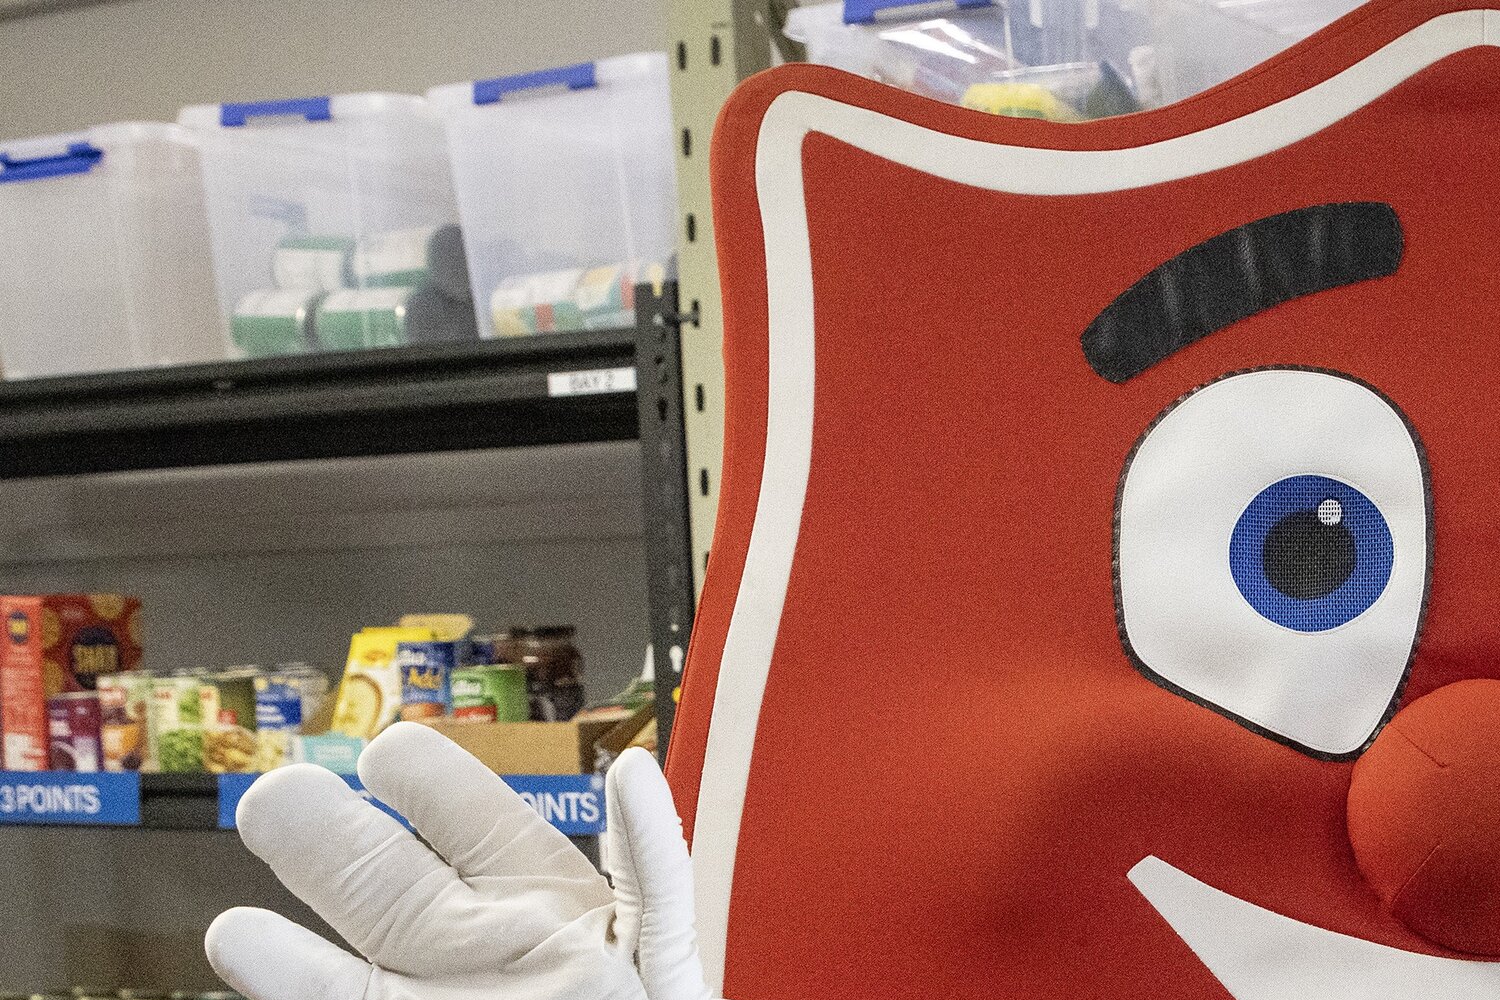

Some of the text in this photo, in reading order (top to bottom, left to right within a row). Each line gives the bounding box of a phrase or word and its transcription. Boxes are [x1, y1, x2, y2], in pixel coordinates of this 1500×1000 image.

[0, 784, 100, 814] 3 POINTS
[520, 791, 600, 823] INTS
